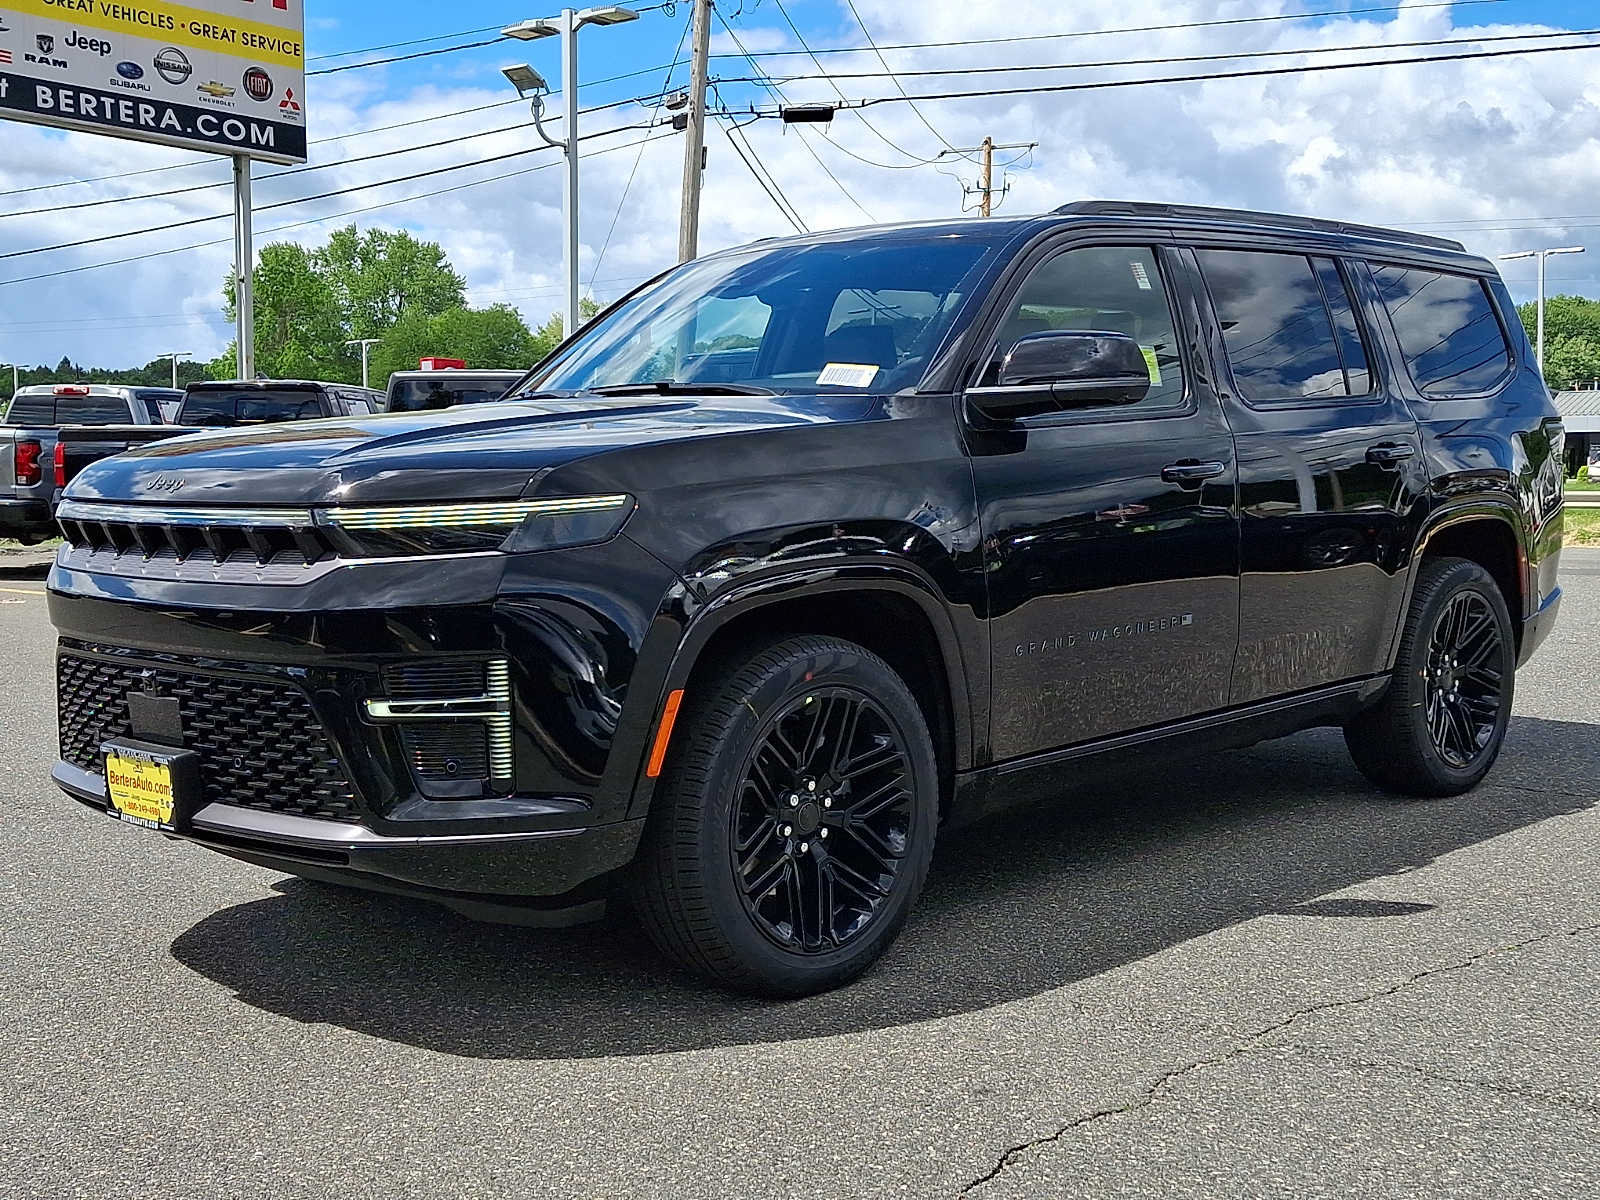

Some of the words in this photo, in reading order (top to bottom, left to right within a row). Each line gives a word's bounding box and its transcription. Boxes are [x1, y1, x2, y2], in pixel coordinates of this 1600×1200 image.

[101, 2, 175, 30] VEHICLES
[189, 21, 237, 44] GREAT
[241, 31, 301, 57] SERVICE
[64, 30, 112, 57] Jeep
[24, 53, 69, 69] RAM
[155, 60, 190, 72] NISSAN
[109, 78, 151, 92] SUBARU
[250, 75, 267, 93] FIAT
[198, 96, 236, 108] CHEVROLET
[35, 84, 275, 147] BERTERA.COM
[146, 474, 185, 494] Jeep
[1015, 635, 1077, 657] GRAND
[1088, 616, 1178, 642] WAGONEER
[109, 770, 171, 796] BerteraAuto.com
